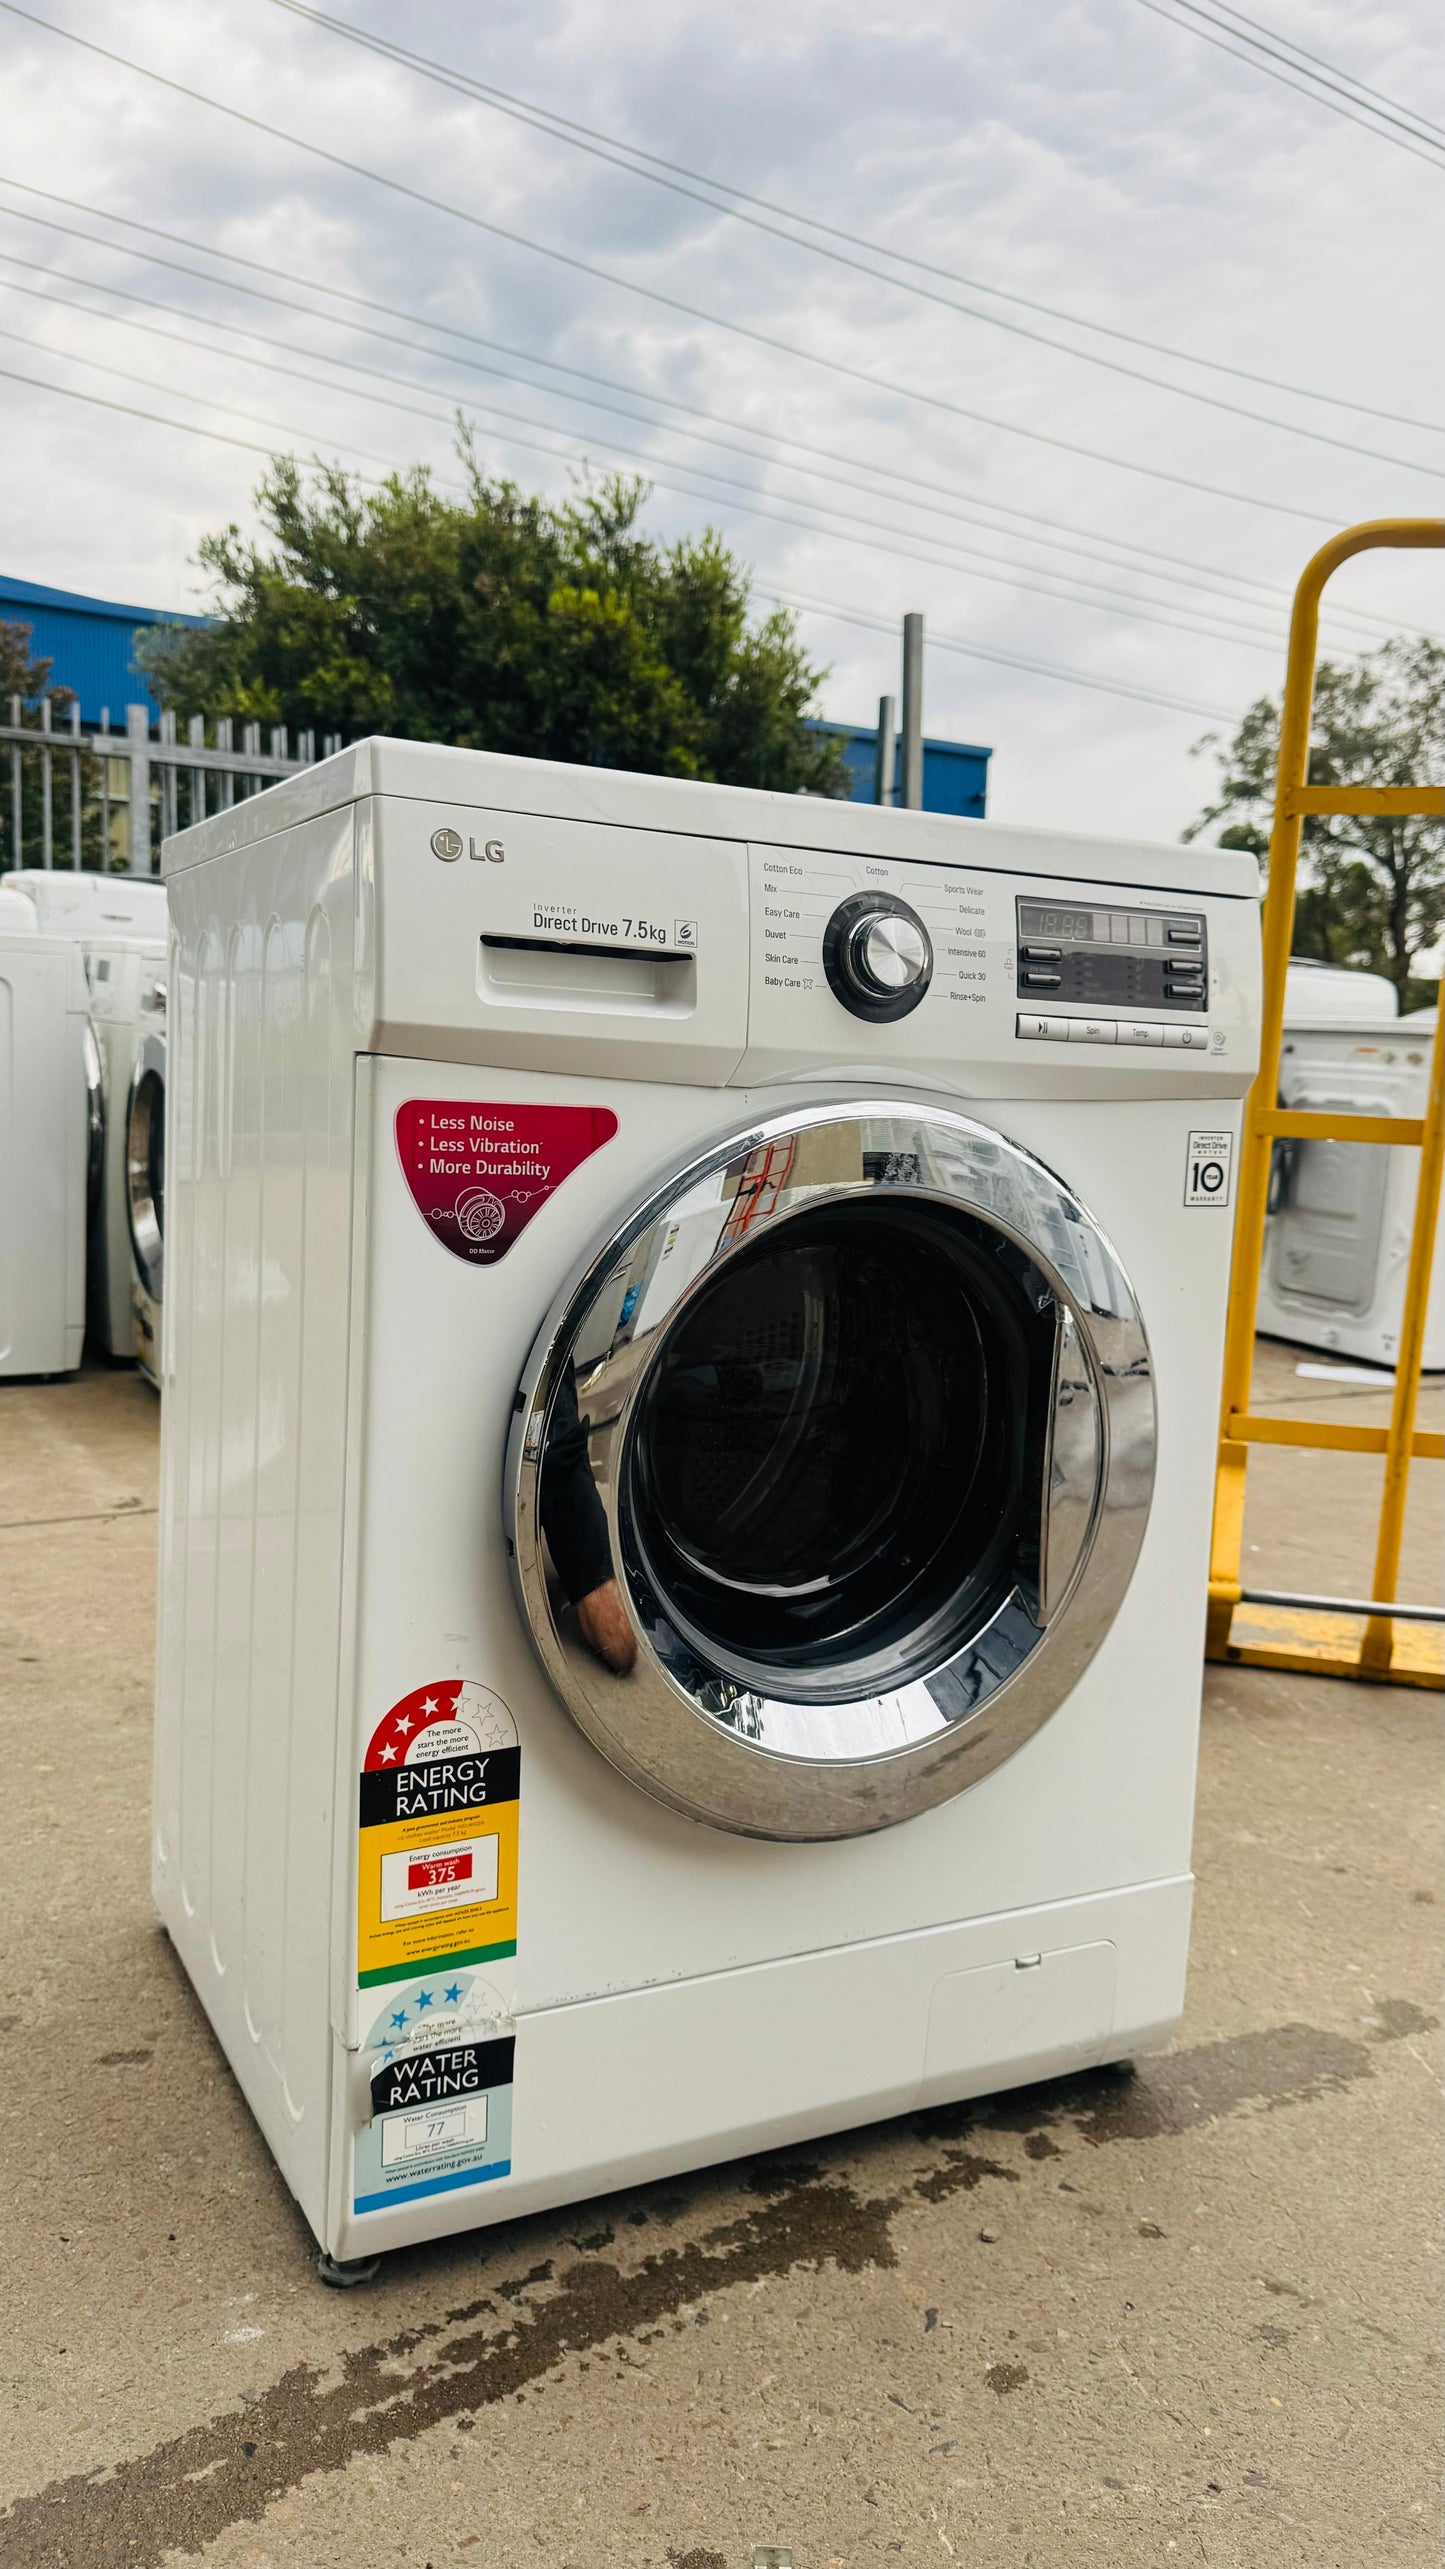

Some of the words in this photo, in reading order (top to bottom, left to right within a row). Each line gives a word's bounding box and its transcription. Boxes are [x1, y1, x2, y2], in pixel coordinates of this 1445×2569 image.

[469, 836, 505, 864] LG
[763, 863, 787, 874] Cotton
[789, 865, 803, 876] Eco
[866, 866, 889, 876] Cotton
[764, 883, 778, 894] Mix
[944, 884, 965, 896] Sports
[966, 887, 984, 897] Wear
[533, 902, 578, 916] Inverter
[765, 907, 782, 919] Easy
[783, 909, 800, 919] Care
[959, 905, 985, 916] Delicate
[532, 912, 578, 933] Direct
[581, 917, 619, 937] Drive
[622, 918, 667, 944] 7.5kg
[765, 929, 786, 940] Duvet
[955, 926, 973, 937] Wool
[765, 953, 781, 964] Skin
[782, 955, 799, 965] Care
[948, 947, 977, 958] Intensive
[977, 949, 987, 959] 60
[765, 976, 784, 988] Baby
[785, 978, 801, 988] Care
[958, 970, 977, 980] Quick
[977, 972, 986, 981] 30
[1086, 1026, 1100, 1035] Spin
[1133, 1028, 1149, 1039] Temp
[430, 1114, 465, 1130] Less
[470, 1116, 515, 1132] Noise
[430, 1136, 464, 1152] Less
[469, 1138, 540, 1154] Vibration
[1193, 1141, 1211, 1149] Direct
[1212, 1142, 1227, 1150] Drive
[430, 1159, 471, 1174] More
[476, 1160, 551, 1180] Durability
[1193, 1162, 1223, 1192] 10
[426, 1729, 441, 1737] The
[442, 1727, 462, 1735] more
[417, 1741, 435, 1749] stars
[436, 1738, 448, 1746] the
[450, 1735, 469, 1744] more
[416, 1749, 440, 1759] energy
[441, 1744, 469, 1754] efficient
[397, 1758, 490, 1793] ENERGY
[396, 1782, 486, 1817] RATING
[409, 1852, 430, 1863] Energy
[432, 1845, 472, 1858] consumption
[421, 1862, 443, 1871] Warm
[444, 1858, 460, 1867] wash
[428, 1866, 456, 1886] 375
[417, 1889, 434, 1898] kWh
[435, 1887, 447, 1896] per
[448, 1884, 461, 1893] year
[413, 2043, 433, 2051] water
[434, 2035, 461, 2047] efficient
[394, 2049, 478, 2082] WATER
[390, 2069, 479, 2106] RATING
[403, 2115, 423, 2124] Water
[425, 2104, 467, 2119] Consumption
[427, 2121, 445, 2138] 77
[385, 2154, 483, 2183] www.waterrating.gov.au
